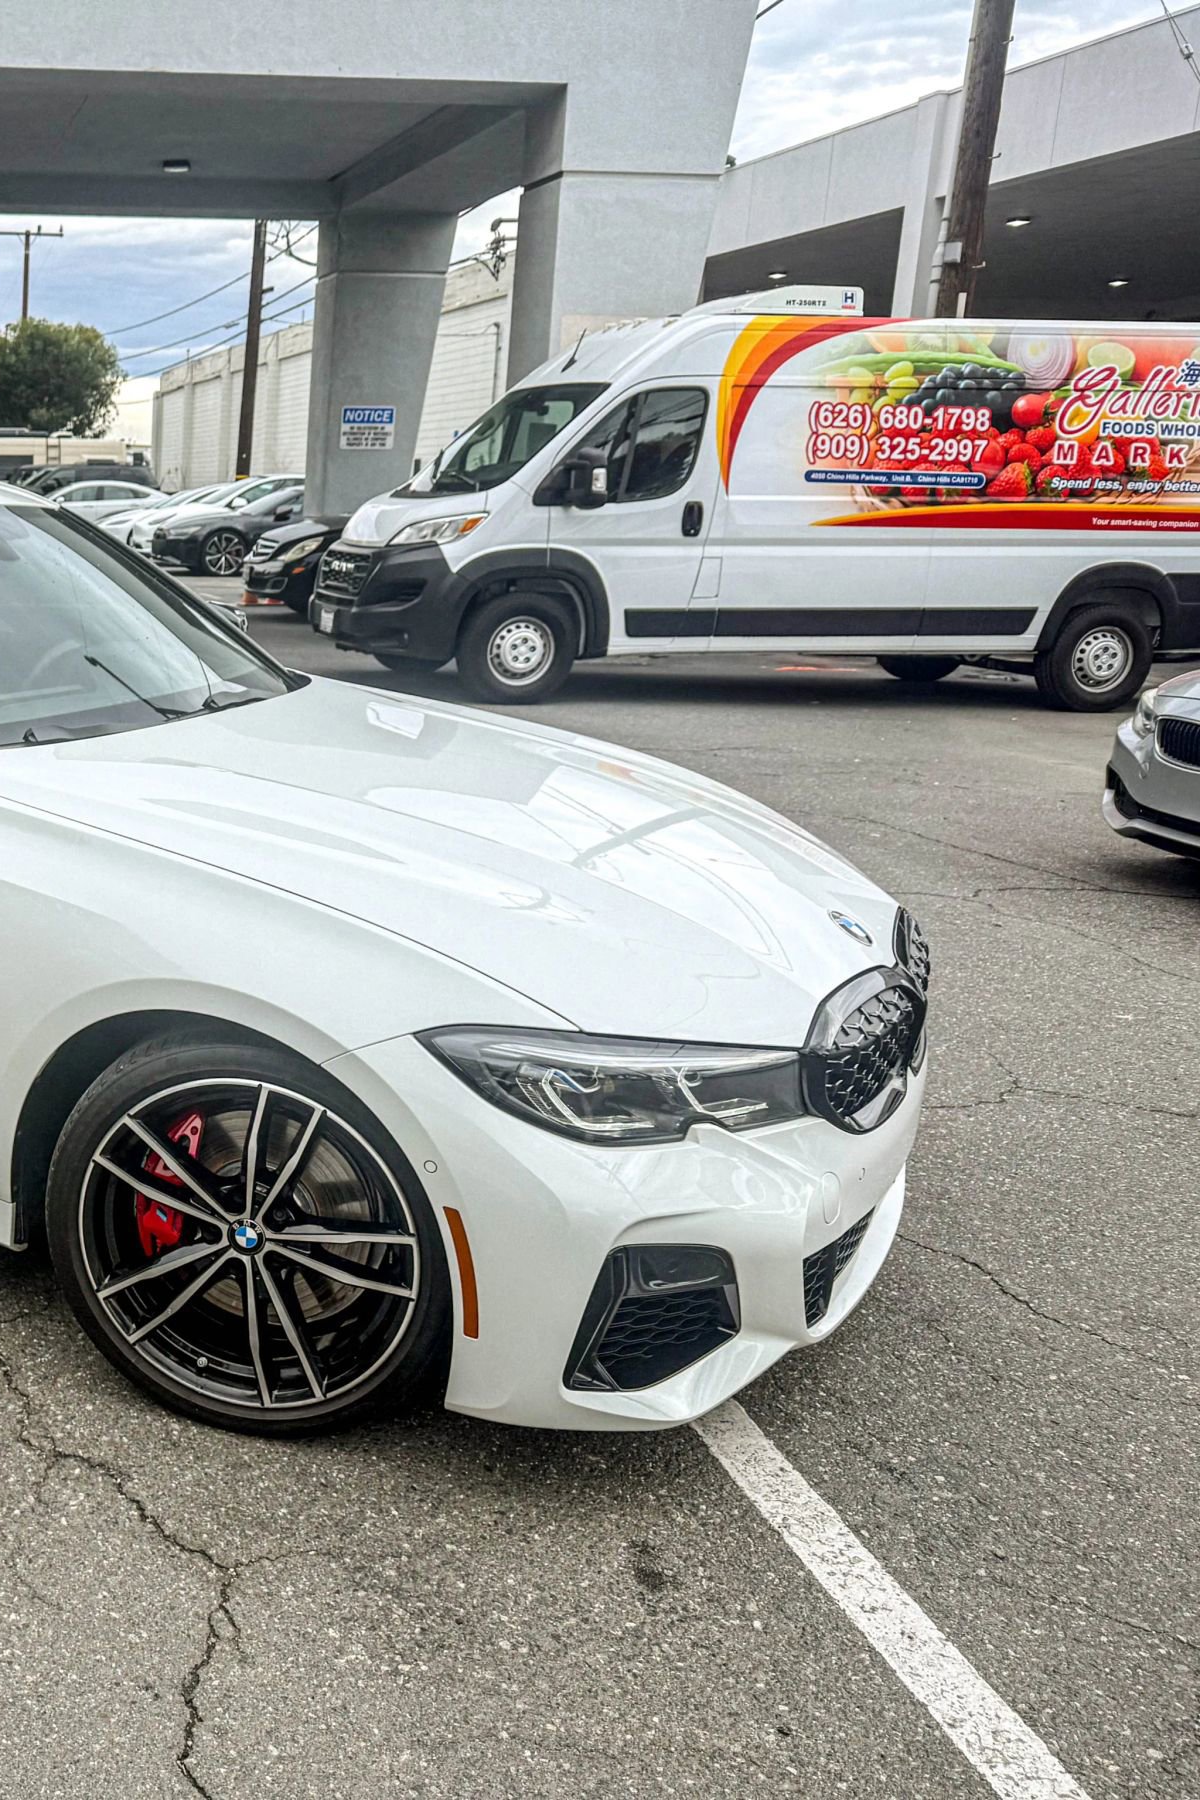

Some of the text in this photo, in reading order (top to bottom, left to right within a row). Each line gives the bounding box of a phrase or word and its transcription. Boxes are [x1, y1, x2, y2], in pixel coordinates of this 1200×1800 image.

[344, 409, 392, 422] NOTICE
[809, 401, 991, 433] (626) 680-1798
[1101, 422, 1155, 435] FOODS
[807, 433, 989, 464] (909) 325-2997
[1056, 443, 1186, 465] MARK
[826, 472, 846, 481] Chino
[846, 473, 860, 481] Hills
[892, 474, 905, 482] Unit
[918, 475, 936, 483] Chino
[937, 476, 951, 484] Hills
[1050, 476, 1092, 490] Spend
[1093, 478, 1124, 491] less,
[1126, 480, 1162, 492] enjoy
[1091, 516, 1200, 529] Your smart-saving companion
